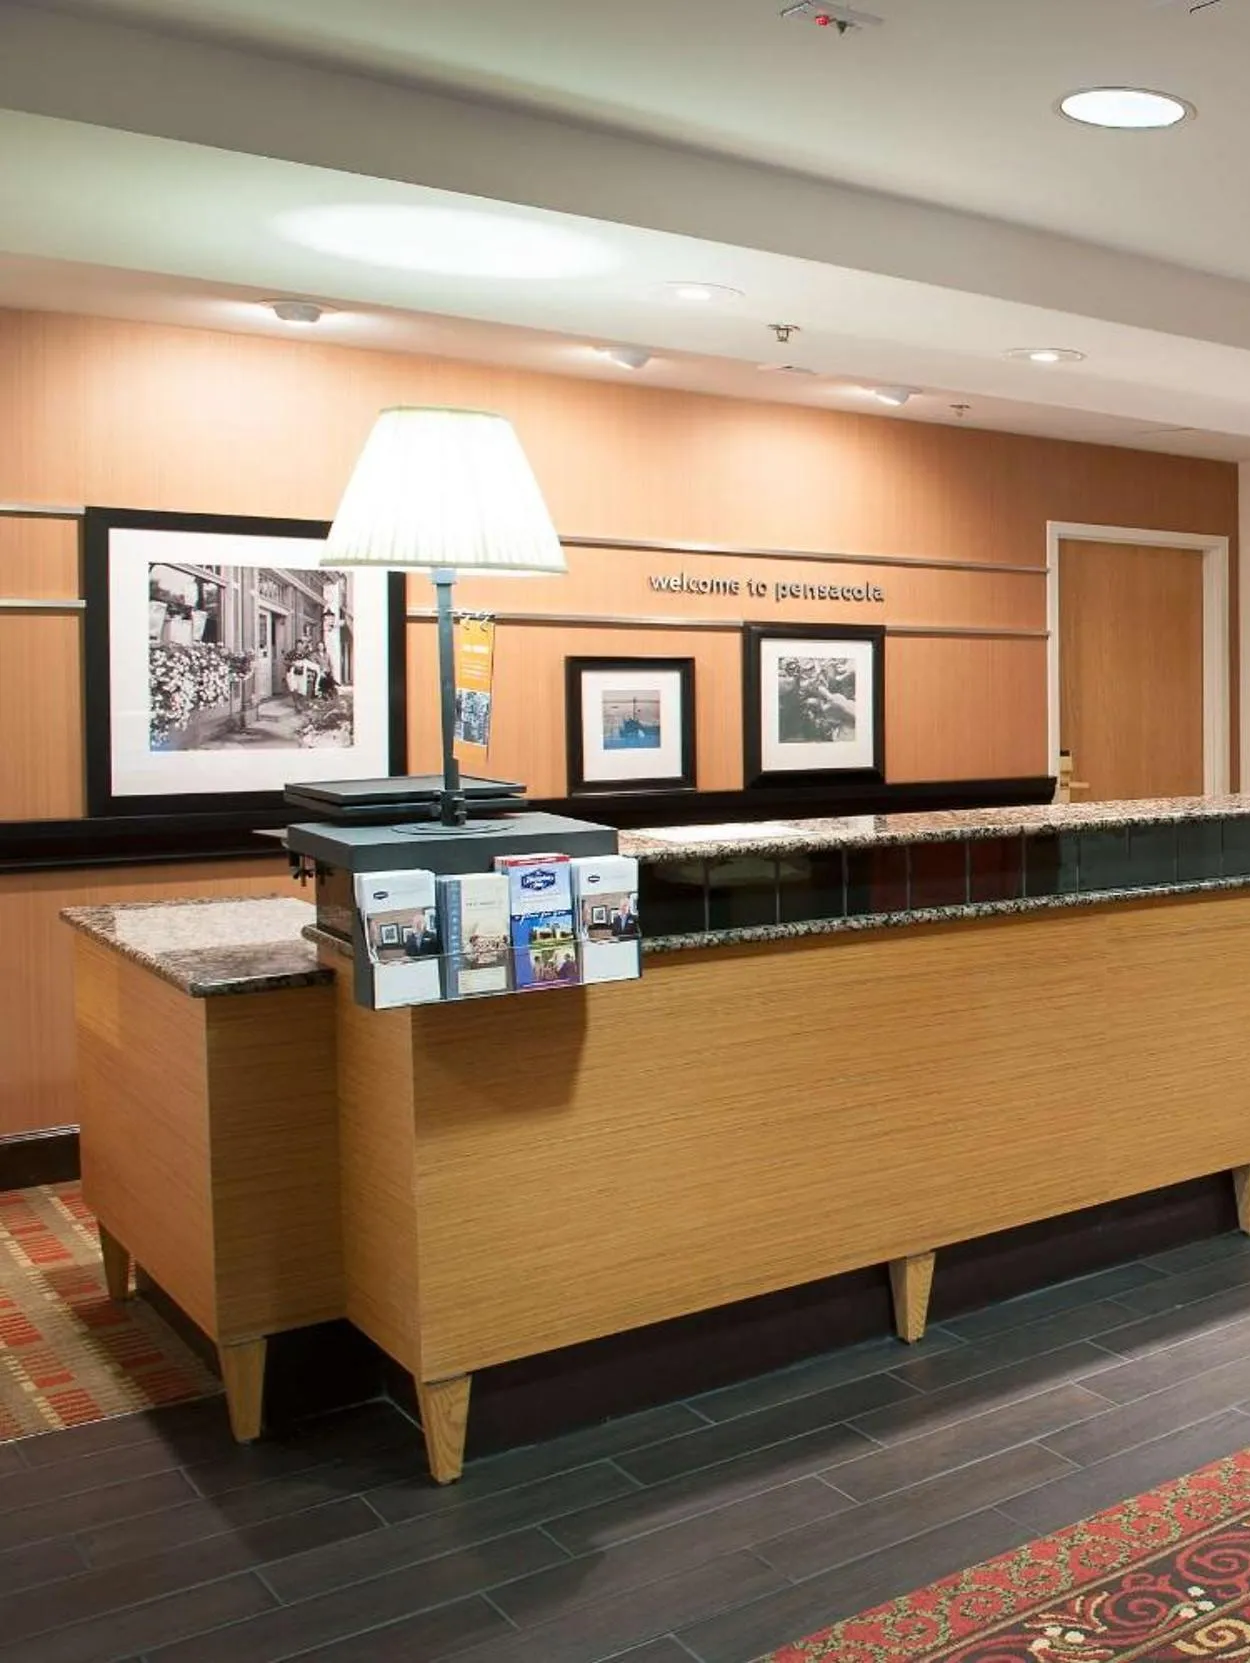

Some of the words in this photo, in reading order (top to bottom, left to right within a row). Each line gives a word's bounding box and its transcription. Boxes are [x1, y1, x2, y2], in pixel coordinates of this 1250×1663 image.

[649, 572, 740, 596] welcome
[747, 578, 768, 598] to
[775, 581, 884, 602] pensacola
